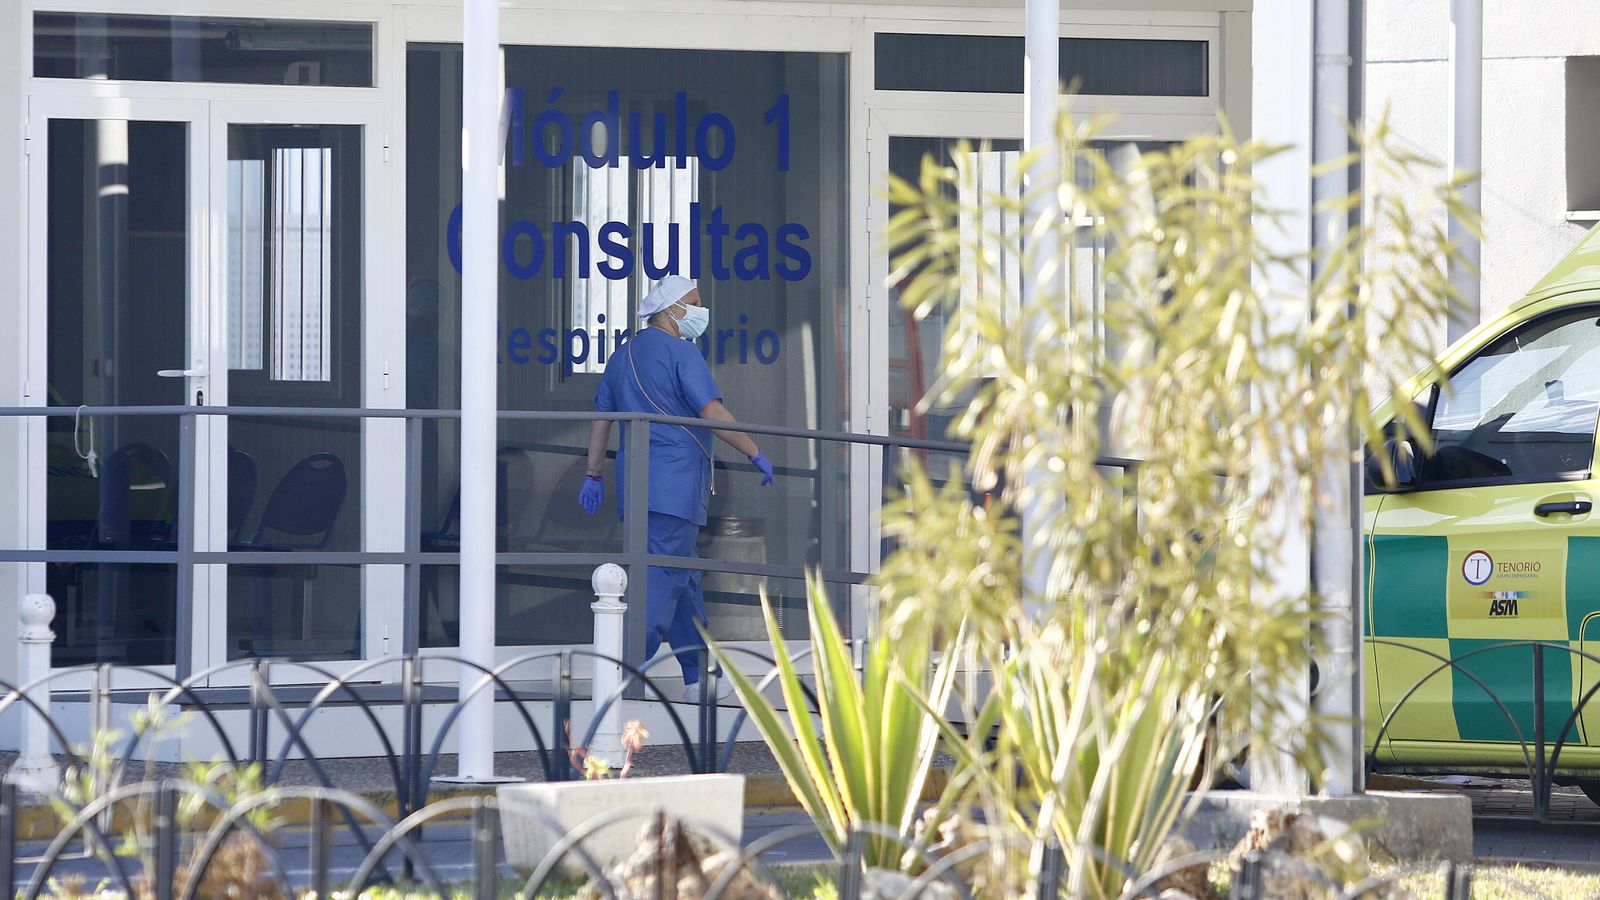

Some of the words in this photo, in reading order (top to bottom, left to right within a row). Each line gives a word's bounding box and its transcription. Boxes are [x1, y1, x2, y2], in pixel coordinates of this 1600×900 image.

[764, 93, 791, 171] 1
[1470, 558, 1487, 580] T
[1497, 562, 1541, 573] TENORIO
[1489, 599, 1518, 616] ASM
